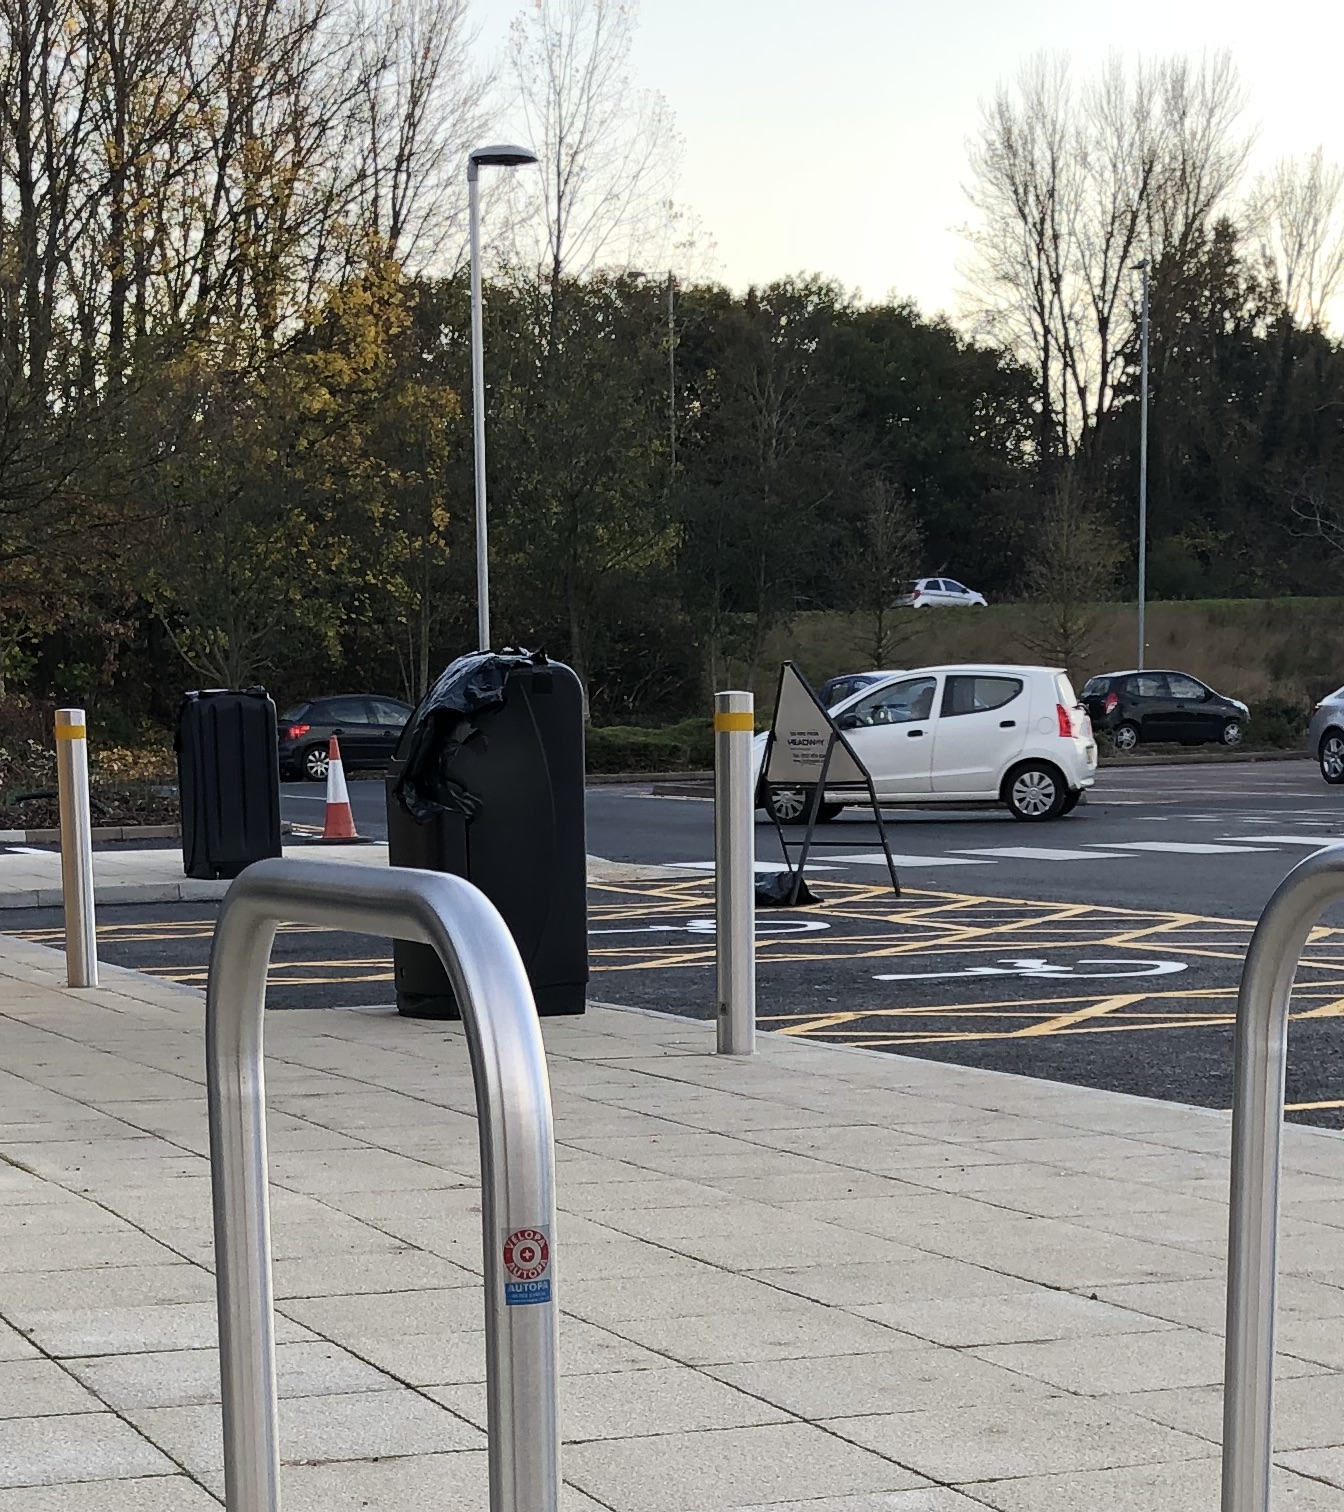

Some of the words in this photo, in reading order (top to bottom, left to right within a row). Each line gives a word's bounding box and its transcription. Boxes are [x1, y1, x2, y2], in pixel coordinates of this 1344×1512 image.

[505, 1230, 546, 1249] VELOPA
[506, 1259, 548, 1279] AUTOPA
[508, 1281, 549, 1292] AUTOPA
